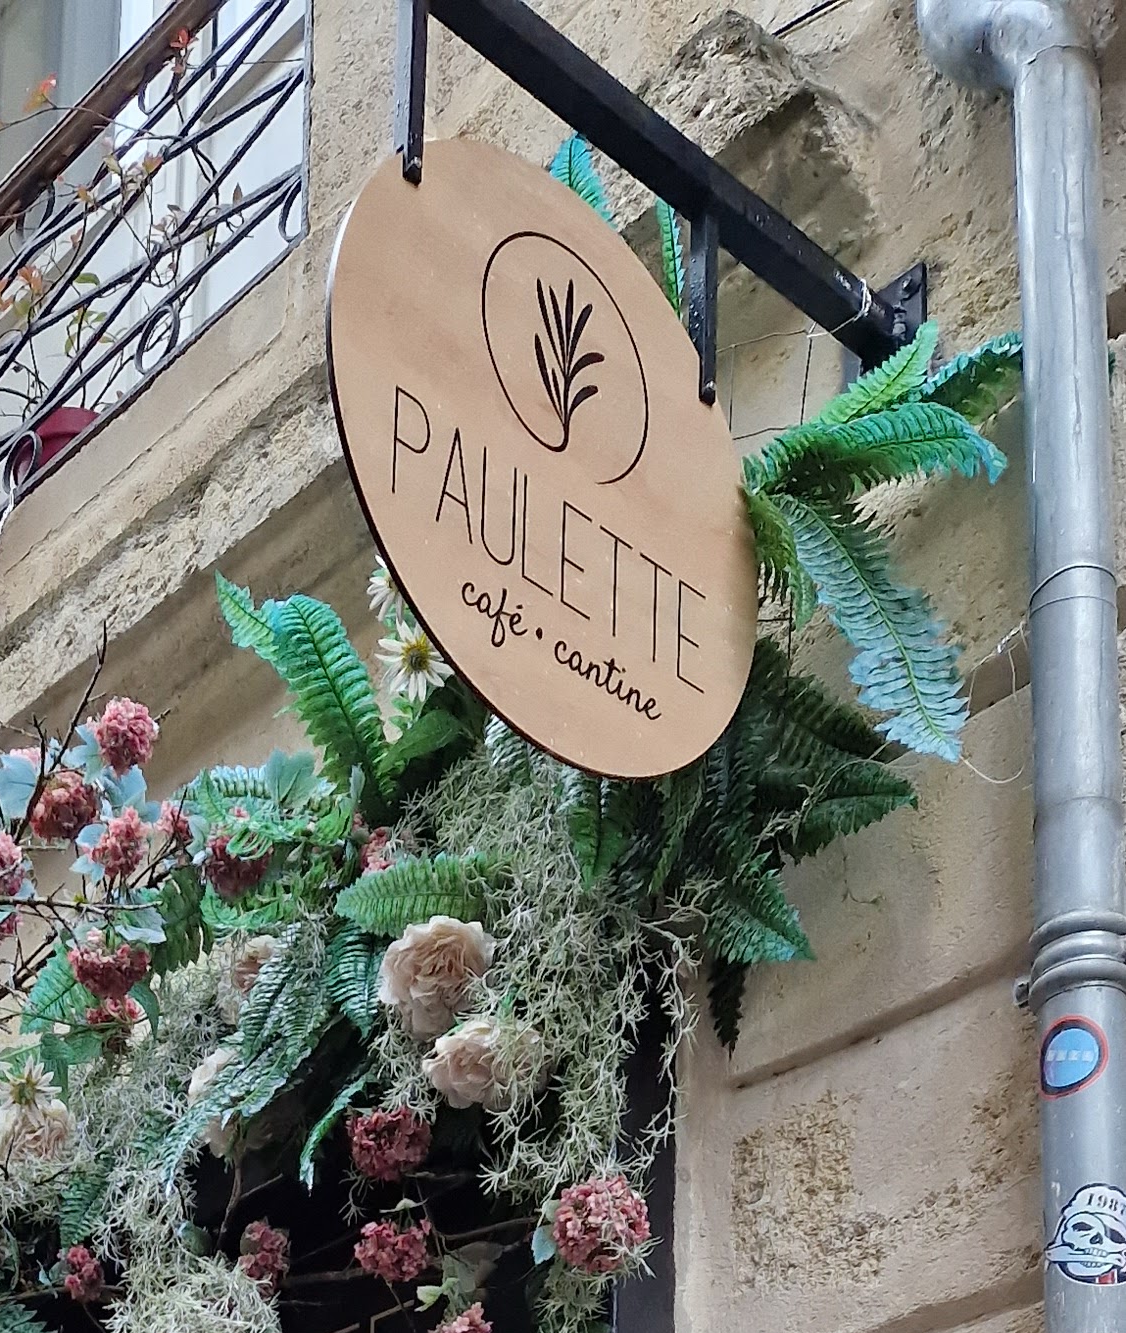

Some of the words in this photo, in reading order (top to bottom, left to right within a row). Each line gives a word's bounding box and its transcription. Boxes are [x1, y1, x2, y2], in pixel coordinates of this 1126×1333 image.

[390, 385, 707, 695] PAULETTE
[462, 580, 529, 650] café
[553, 640, 662, 721] cantine
